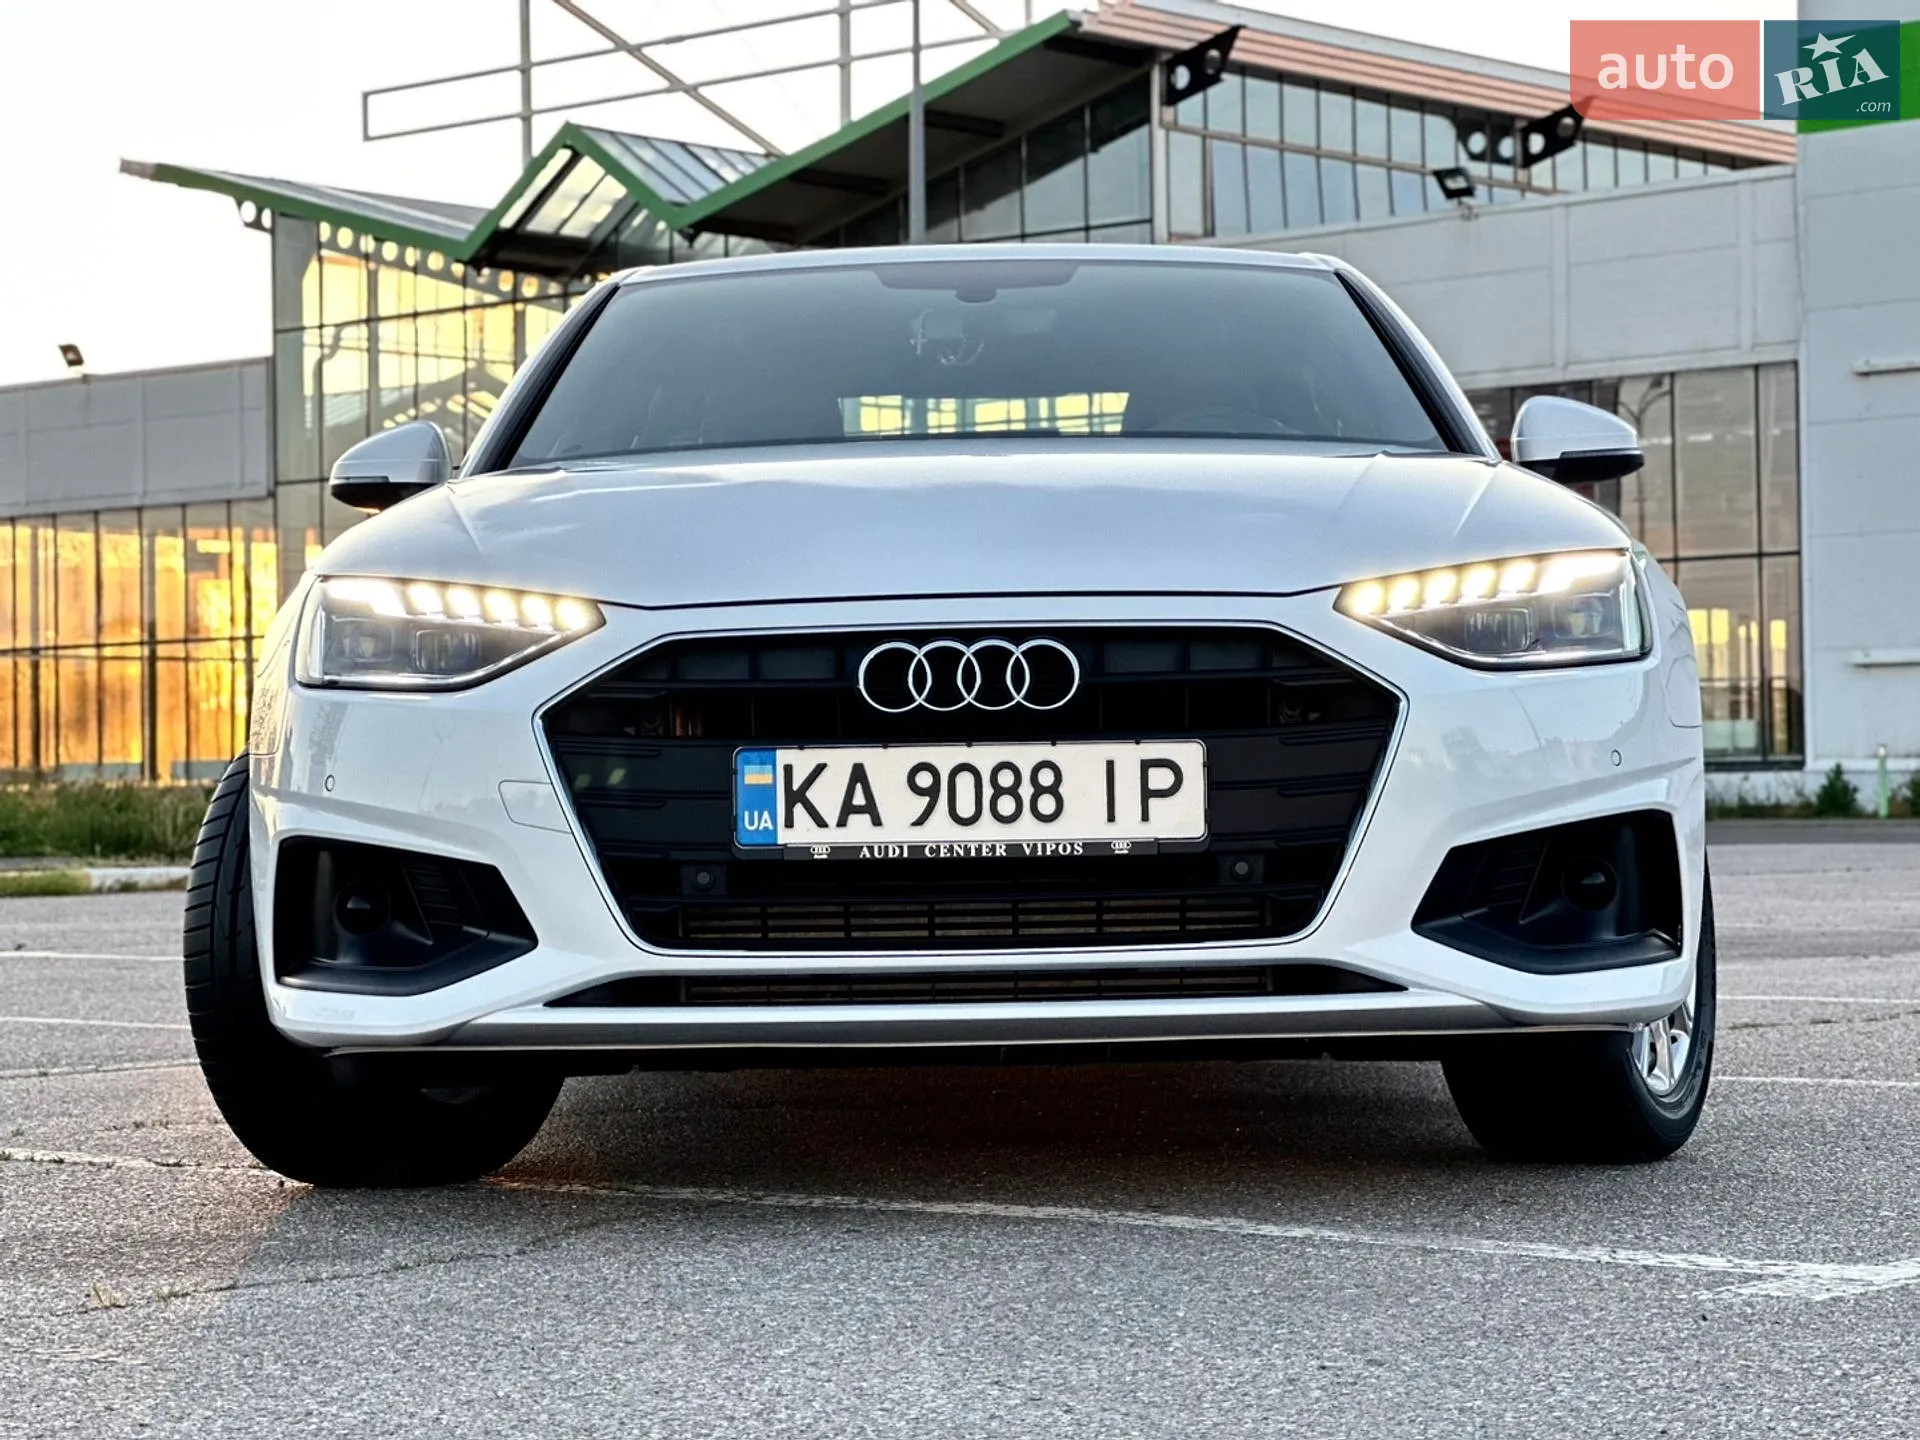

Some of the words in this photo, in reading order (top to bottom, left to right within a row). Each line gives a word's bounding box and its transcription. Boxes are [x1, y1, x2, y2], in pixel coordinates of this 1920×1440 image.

[783, 762, 883, 829] KA
[906, 759, 1064, 827] 9088
[1105, 758, 1184, 823] IP
[743, 810, 775, 831] UA
[859, 844, 909, 859] AUDI
[924, 843, 1007, 858] CENTER
[1022, 841, 1084, 857] VIPOS
